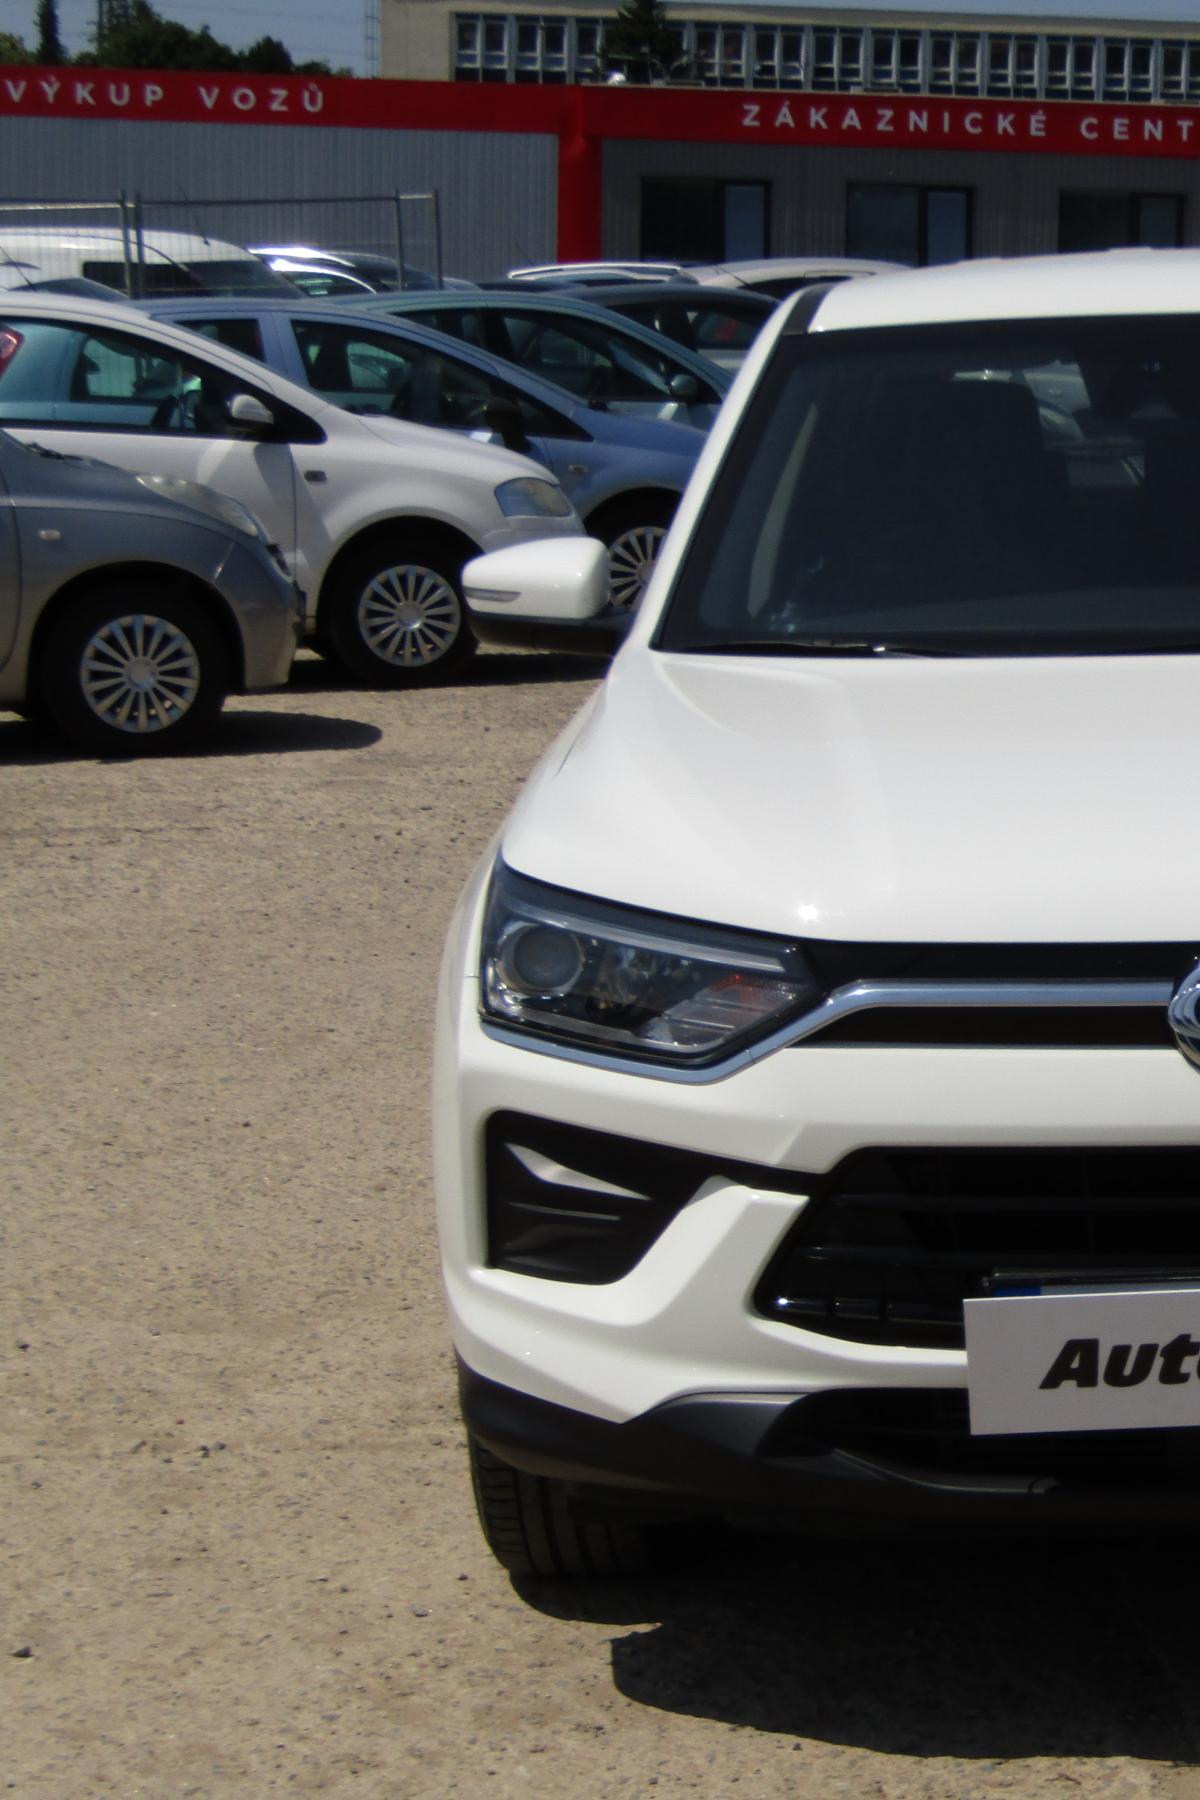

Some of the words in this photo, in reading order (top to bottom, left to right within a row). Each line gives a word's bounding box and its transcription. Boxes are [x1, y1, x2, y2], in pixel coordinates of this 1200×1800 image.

[5, 76, 165, 107] VÝKUP
[198, 83, 325, 113] VOZŮ
[741, 101, 1048, 137] ZÁKAZNICKÉ
